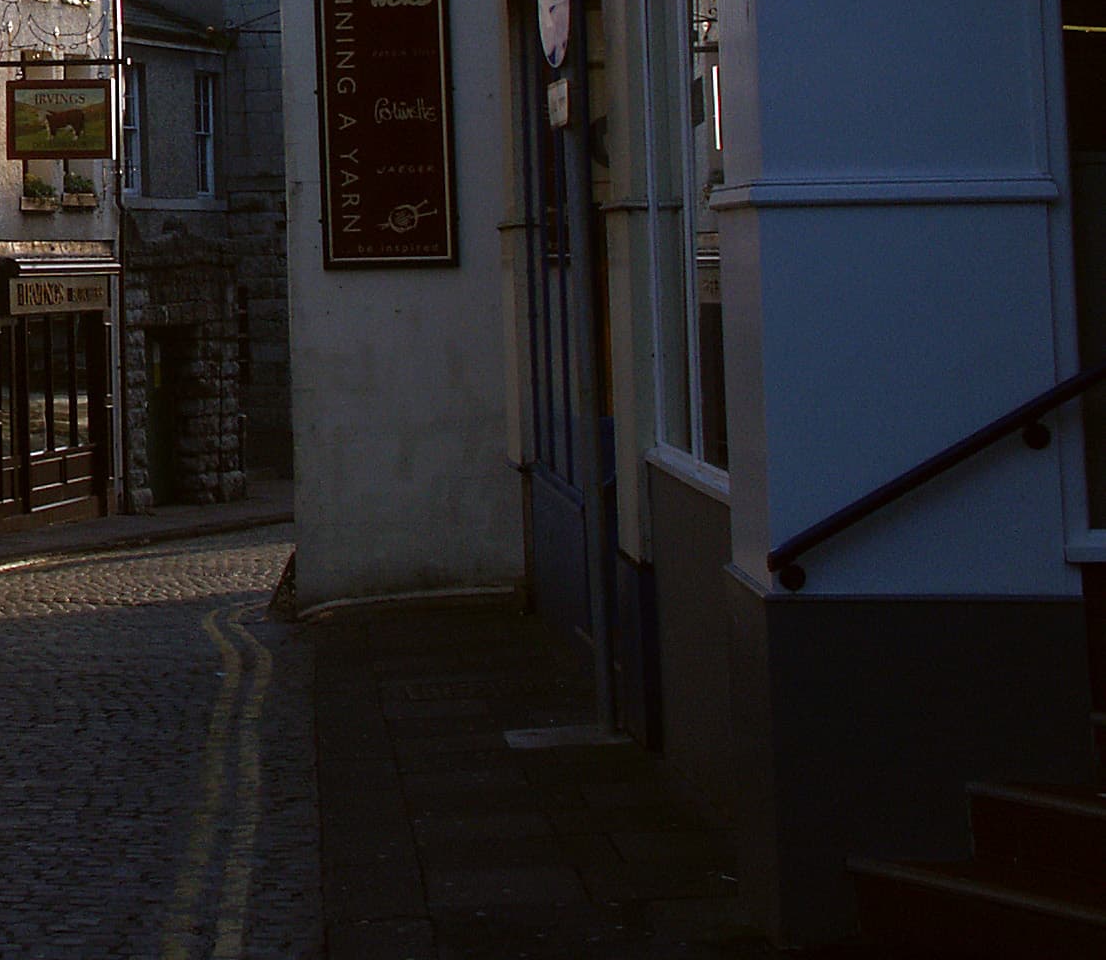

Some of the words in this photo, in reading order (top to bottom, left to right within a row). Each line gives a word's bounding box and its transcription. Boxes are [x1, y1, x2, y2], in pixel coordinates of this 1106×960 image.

[34, 93, 86, 105] IRVINGS
[337, 112, 358, 131] A
[339, 148, 363, 233] YARN
